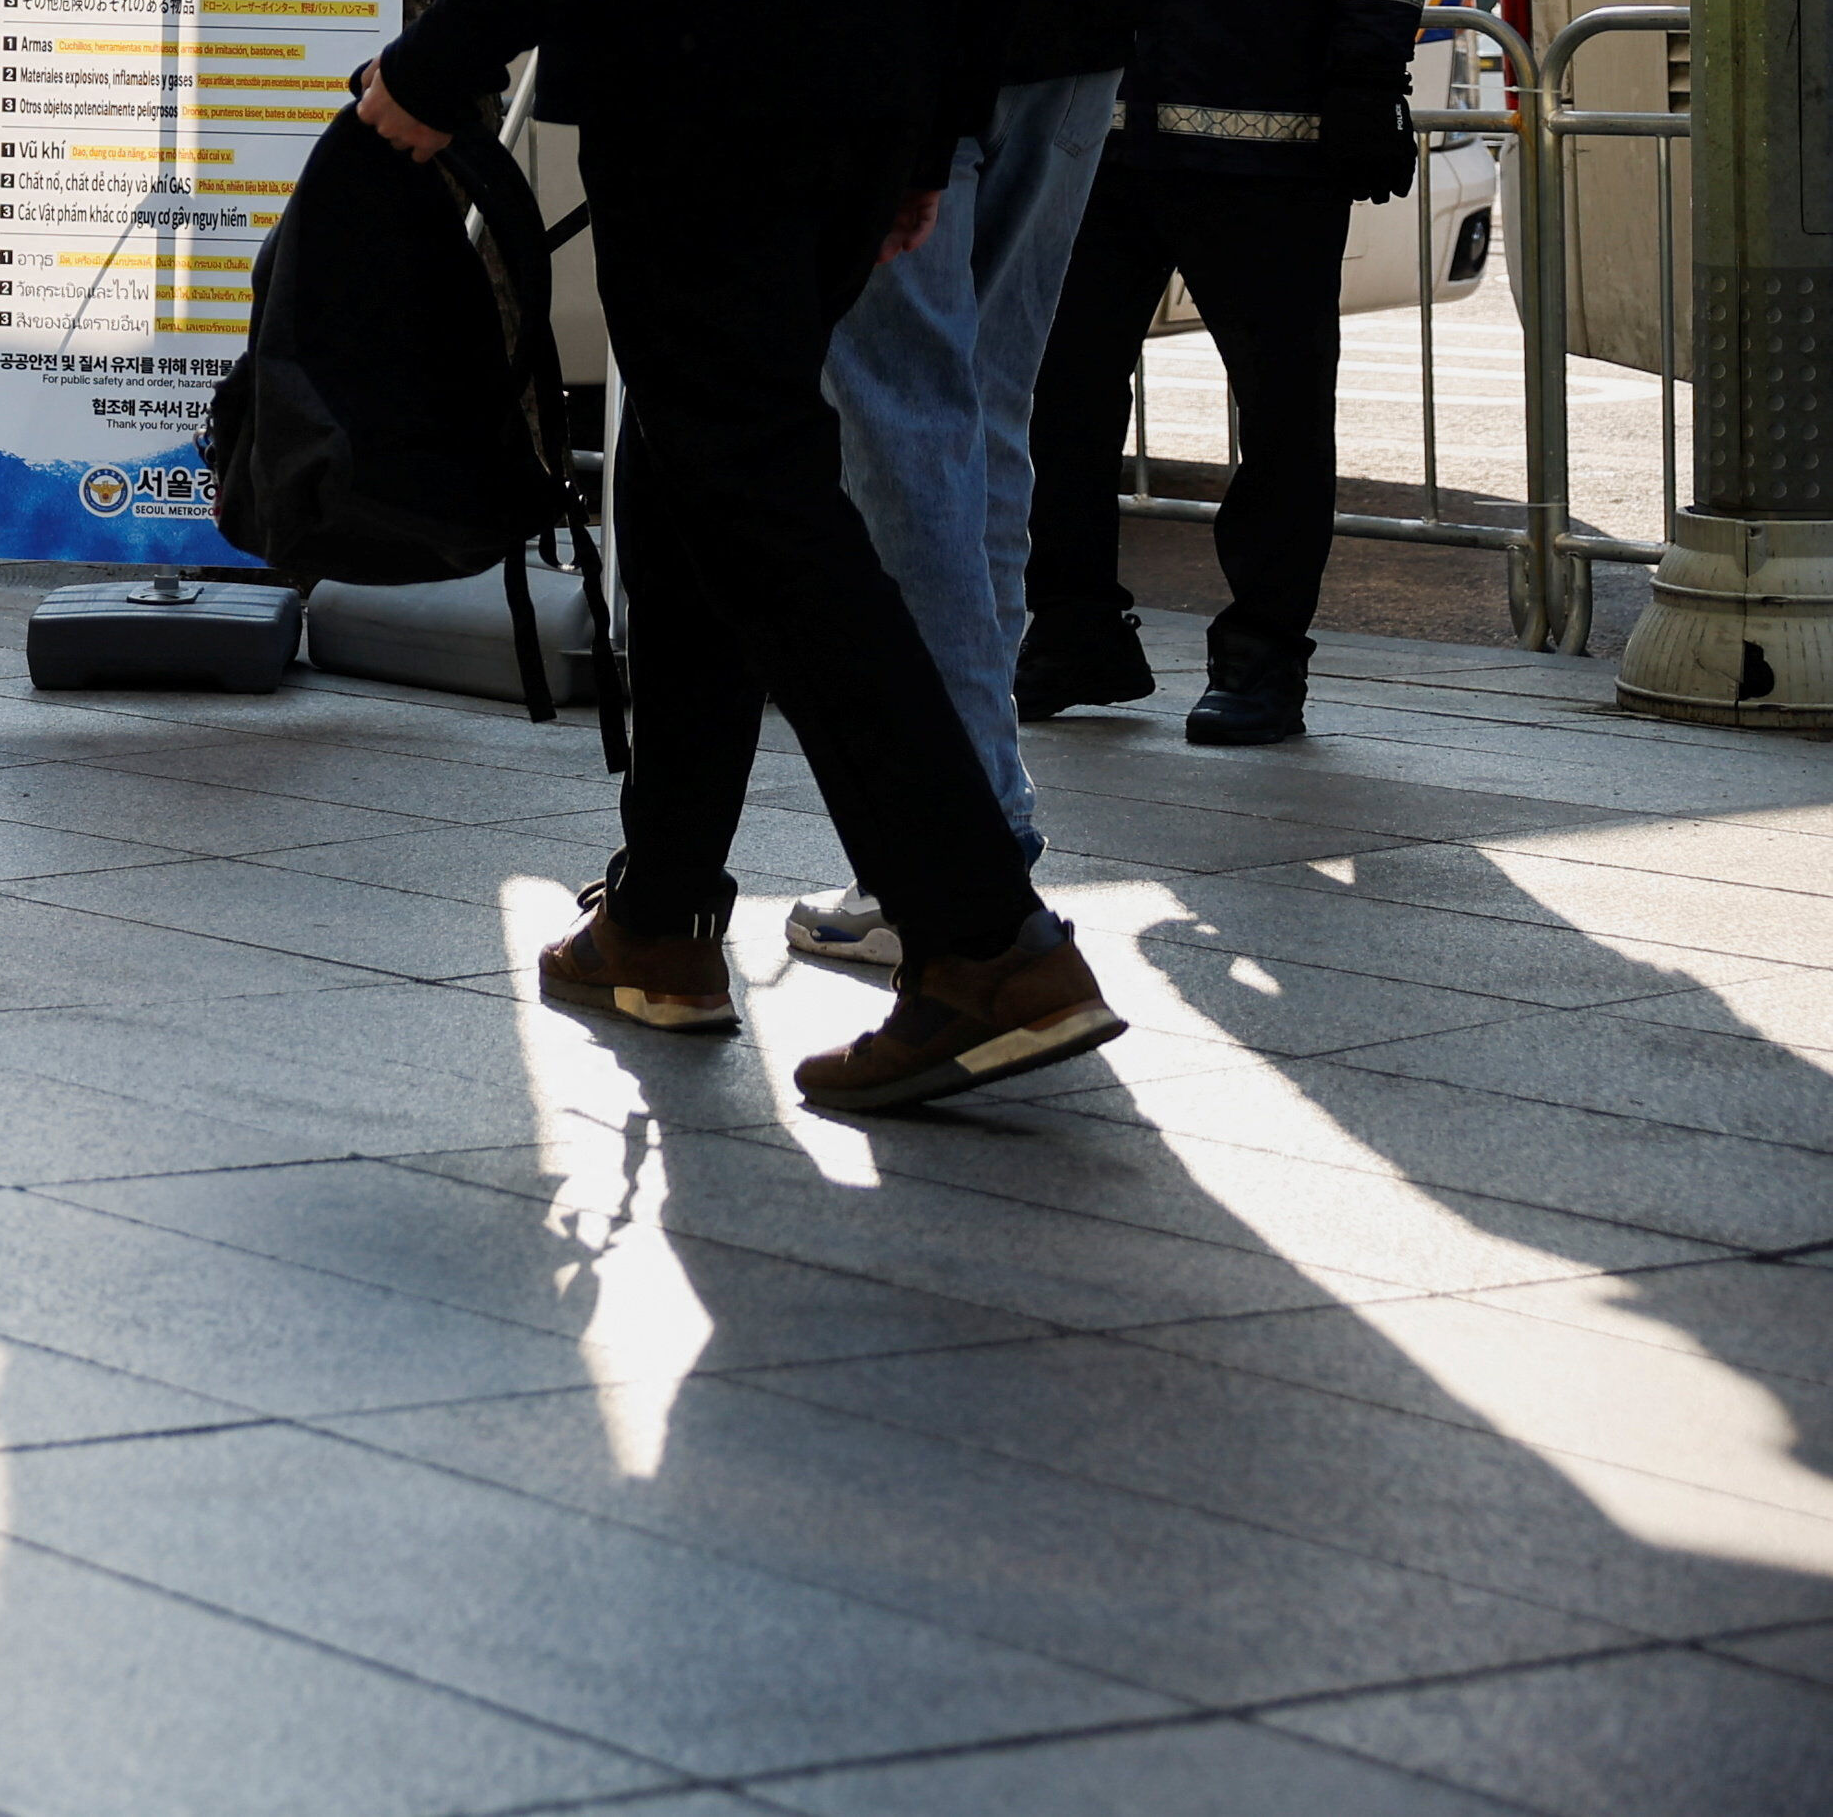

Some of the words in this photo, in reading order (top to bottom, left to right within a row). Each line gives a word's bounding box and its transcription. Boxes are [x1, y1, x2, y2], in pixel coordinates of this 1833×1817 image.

[21, 37, 52, 53] Armas
[20, 67, 63, 84] Materiales
[65, 70, 111, 89] explosivos,
[113, 69, 160, 86] inflamables
[168, 76, 193, 91] gases
[20, 99, 41, 113] Otros
[43, 100, 72, 118] objetos
[74, 99, 135, 118] potencialmente
[137, 101, 178, 121] peligrosos
[19, 140, 37, 159] Vũ
[42, 140, 66, 159] khí
[19, 170, 43, 191] Chất
[65, 173, 88, 191] chất
[107, 173, 132, 196] cháy
[136, 174, 148, 193] và
[150, 173, 168, 193] khí
[170, 177, 191, 194] GAS
[18, 201, 36, 221] Các
[39, 203, 55, 226] Vật
[89, 204, 114, 223] khác
[116, 205, 128, 223] có
[130, 211, 155, 228] nguy
[172, 207, 191, 230] gây
[192, 213, 218, 231] nguy
[0, 353, 58, 372] 공공안전
[61, 355, 76, 372] 및
[78, 355, 107, 373] 질서
[110, 356, 154, 374] 유지를
[158, 358, 187, 376] 위해
[42, 374, 58, 384] For
[61, 374, 91, 386] public
[93, 375, 124, 387] safety
[126, 377, 145, 386] and
[147, 378, 176, 389] order,
[92, 397, 135, 416] 협조해
[138, 400, 182, 418] 주셔서
[106, 418, 136, 429] Thank
[139, 422, 157, 431] you
[159, 420, 173, 430] for
[176, 422, 199, 433] your
[135, 505, 165, 515] SEOUL
